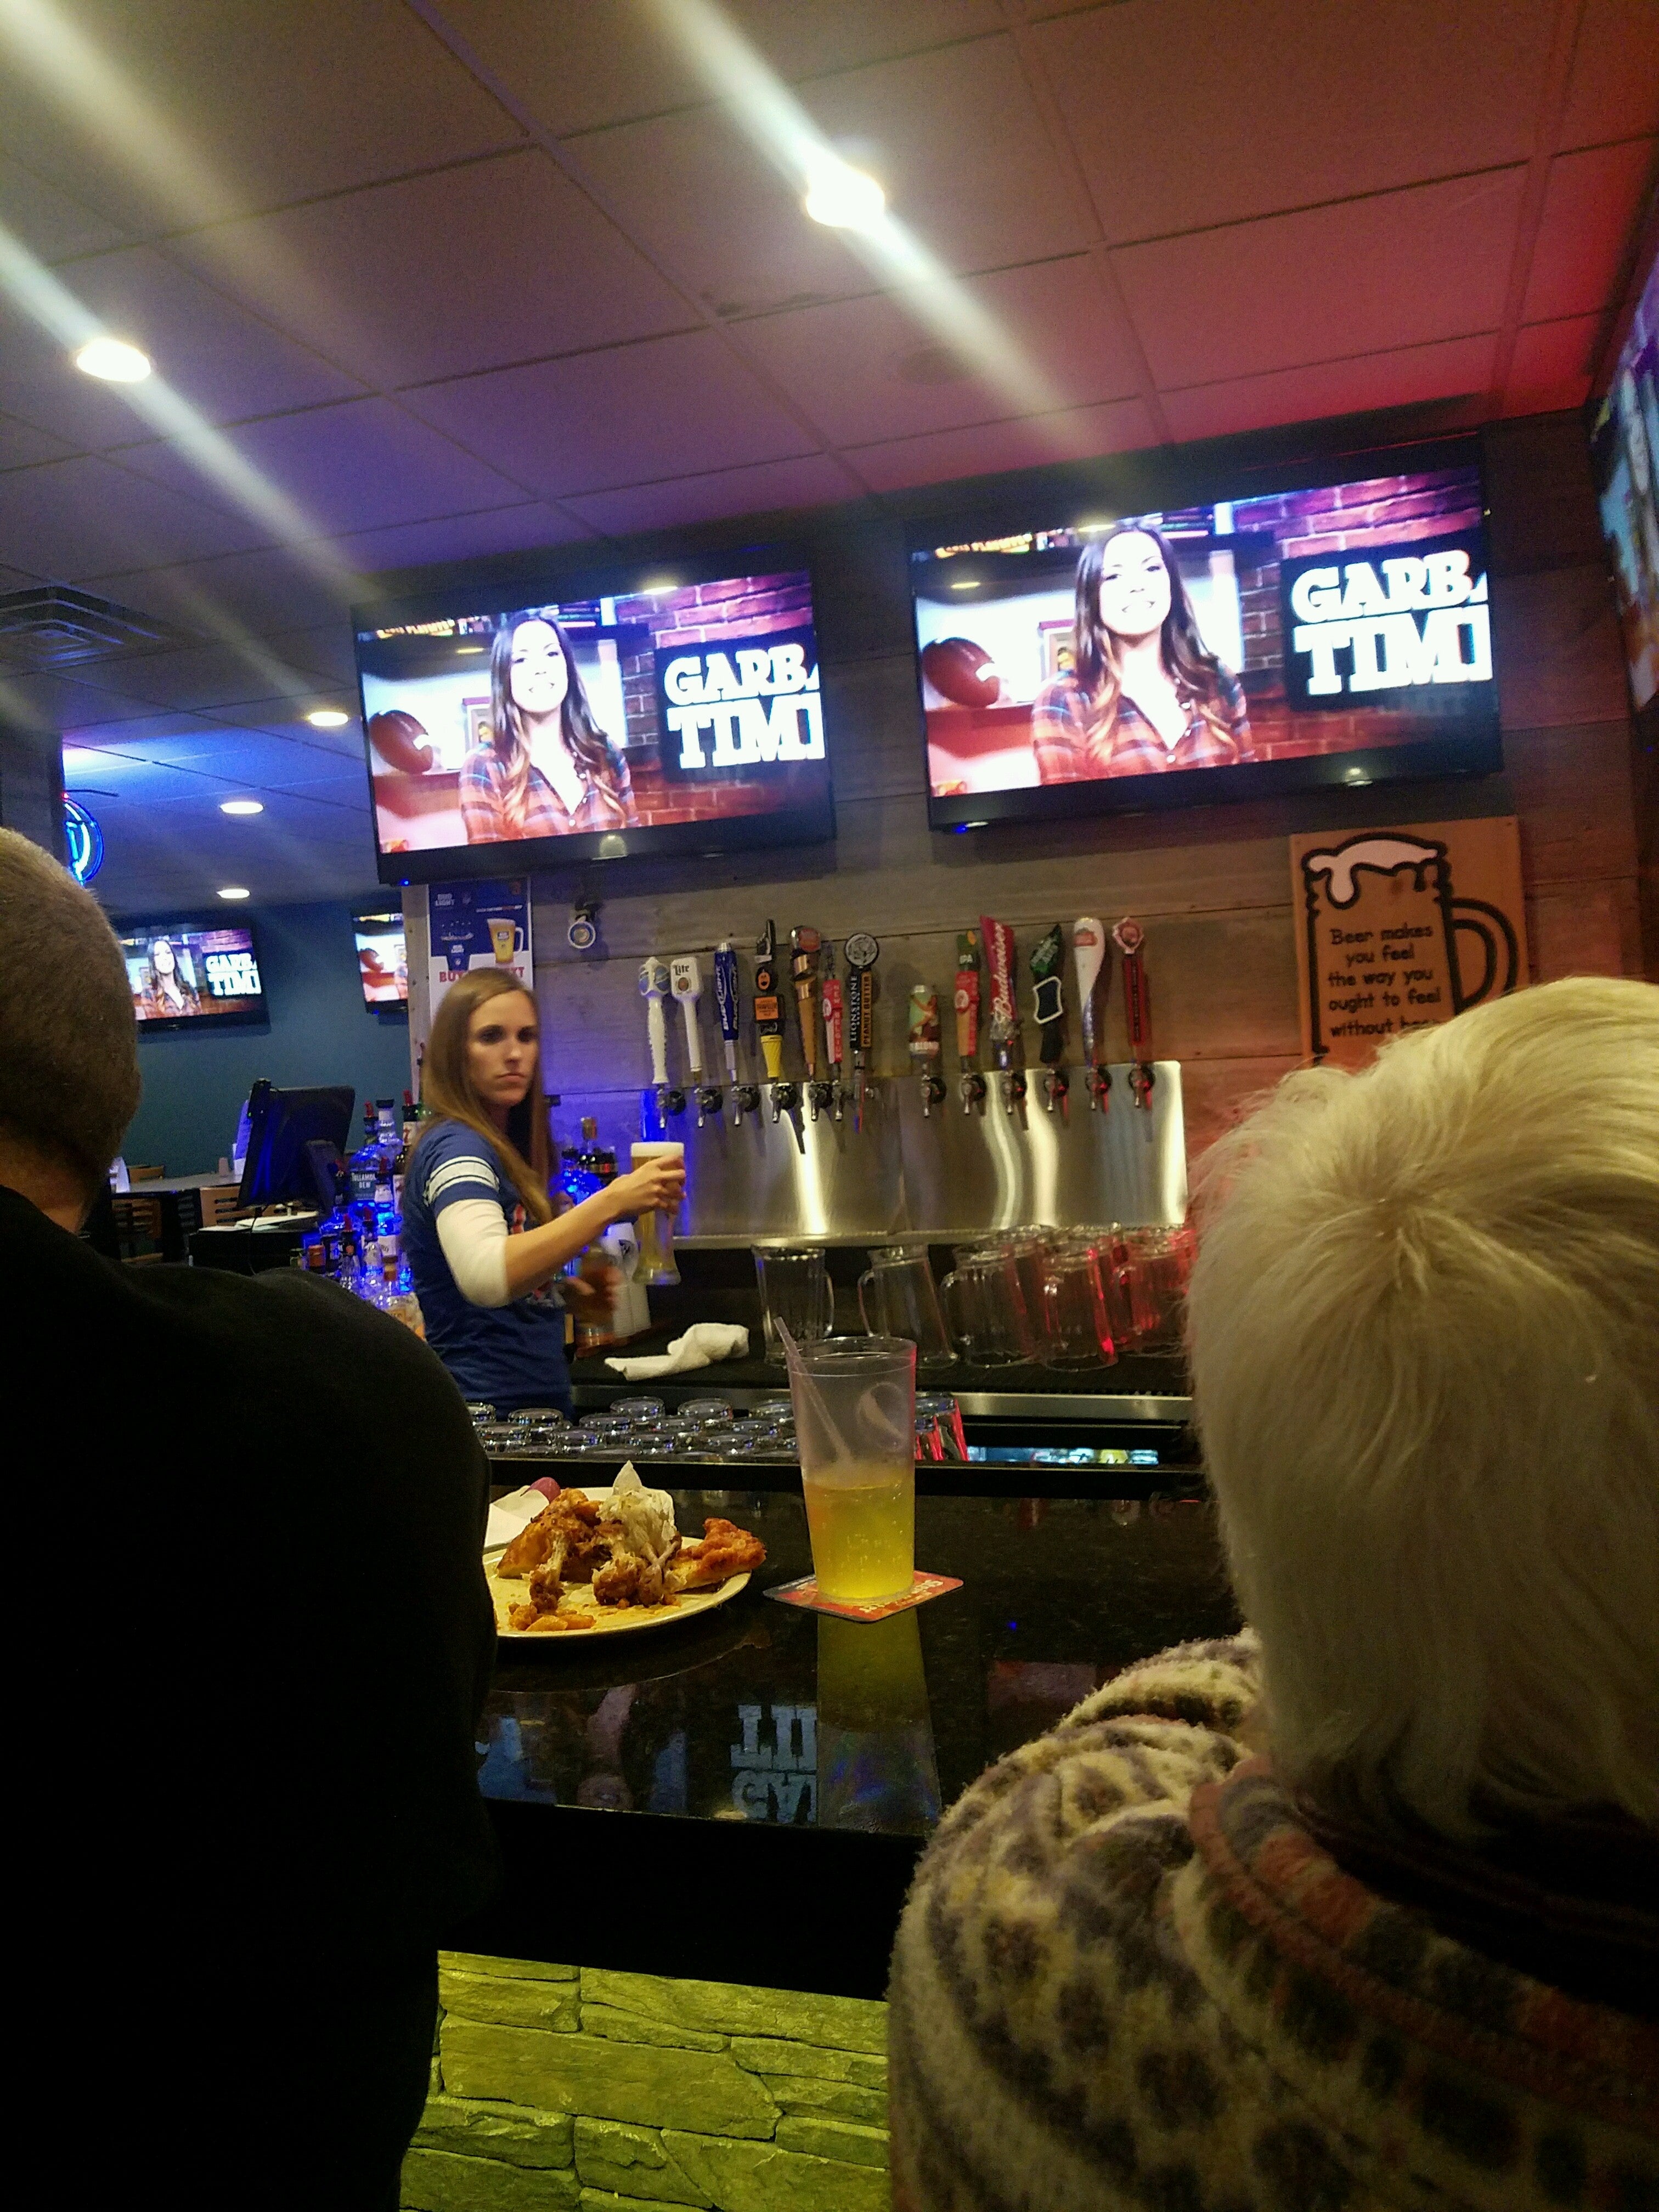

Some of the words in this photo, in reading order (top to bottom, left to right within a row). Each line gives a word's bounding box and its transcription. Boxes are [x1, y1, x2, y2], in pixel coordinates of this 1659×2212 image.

[1330, 929, 1374, 944] Beer
[1380, 923, 1433, 940] makes
[1346, 951, 1375, 967] you
[1383, 942, 1415, 961] feel
[673, 964, 690, 975] Lite
[992, 922, 1012, 1022] Budweiser
[1328, 971, 1356, 986] the
[1362, 971, 1396, 986] way
[1403, 969, 1434, 985] you
[1328, 991, 1374, 1013] ought
[1382, 990, 1400, 1007] to
[1407, 986, 1442, 1005] feel
[1331, 1018, 1394, 1036] without
